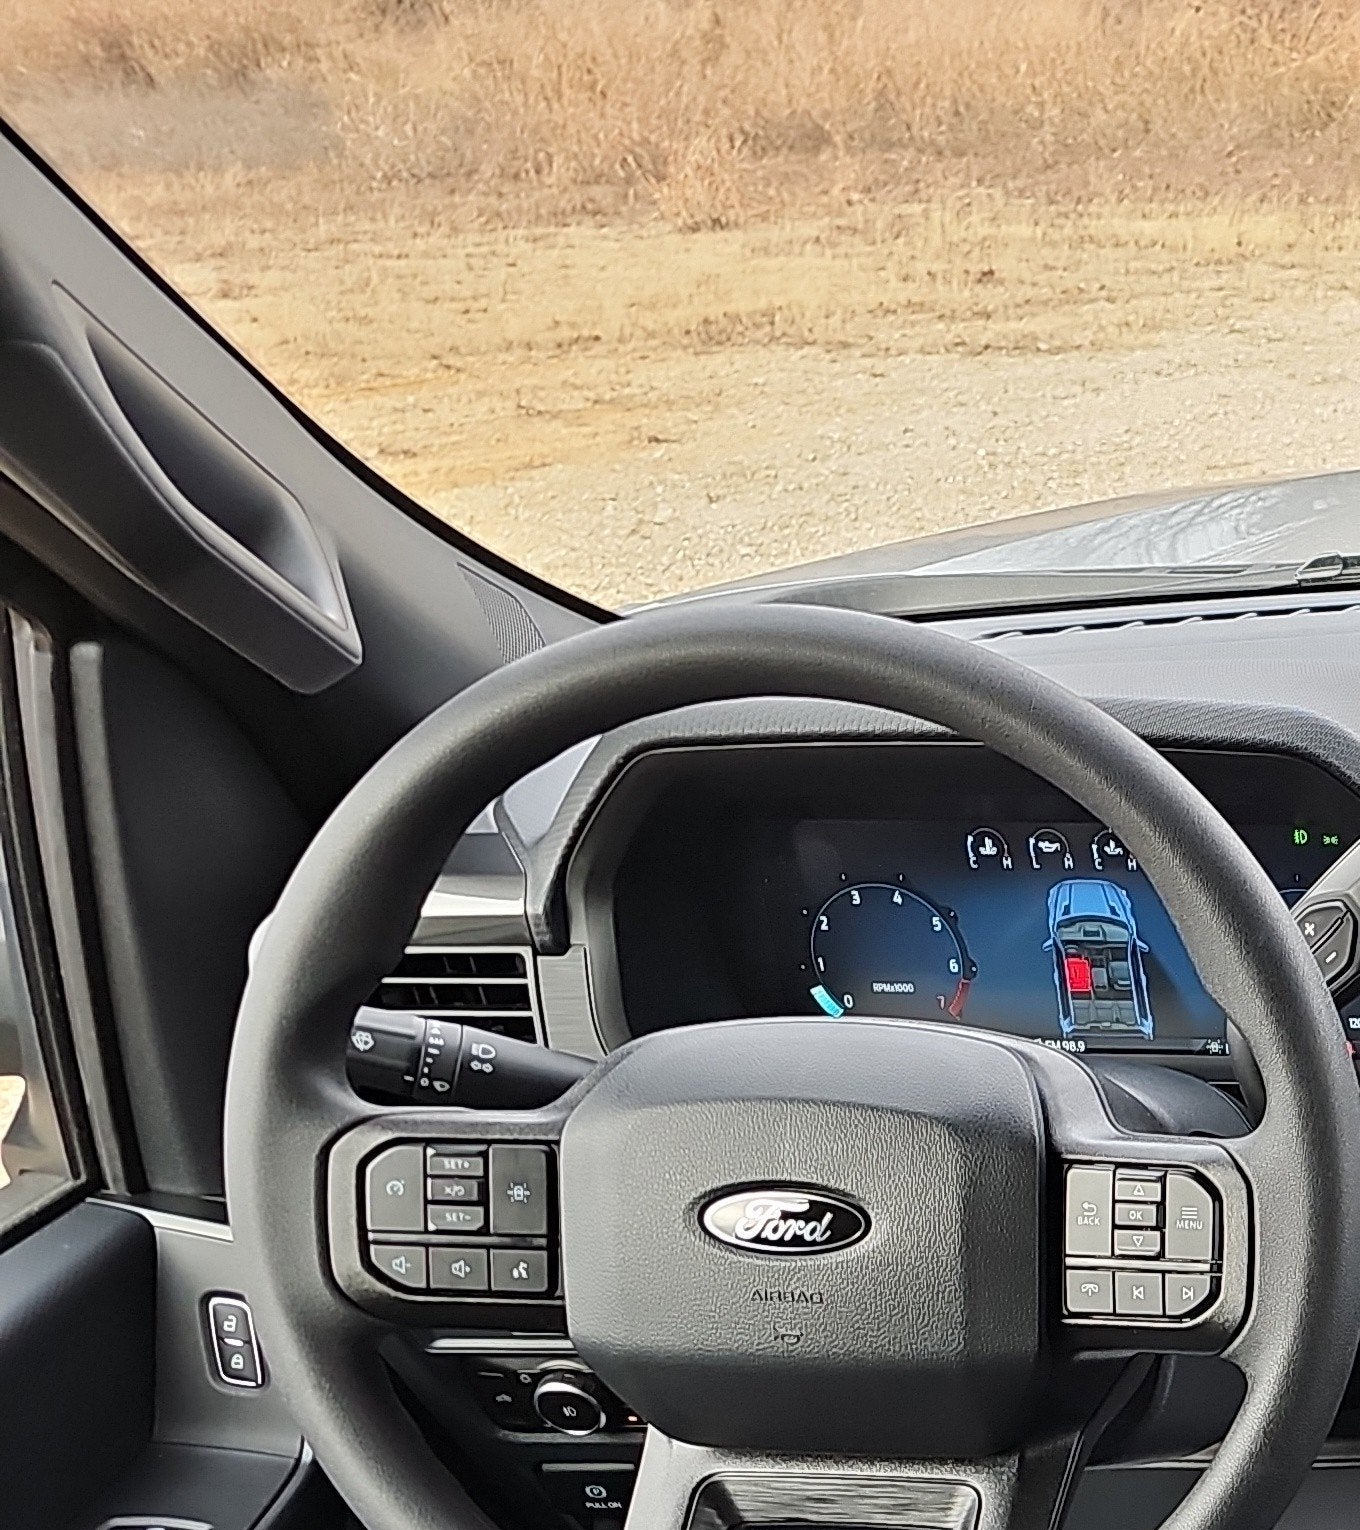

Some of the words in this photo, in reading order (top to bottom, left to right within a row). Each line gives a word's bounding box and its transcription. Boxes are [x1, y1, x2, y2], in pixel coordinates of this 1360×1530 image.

[850, 890, 861, 905] 3
[892, 890, 903, 906] 4
[819, 915, 829, 931] 2
[932, 916, 942, 931] 5
[817, 956, 825, 972] 1
[949, 958, 959, 973] 6
[843, 994, 854, 1009] 0
[936, 995, 945, 1010] 7
[1062, 1040, 1086, 1053] 98.9
[734, 1197, 834, 1242] Ford
[1077, 1215, 1101, 1226] BACK
[1128, 1209, 1143, 1221] OK
[1176, 1219, 1203, 1230] MENU
